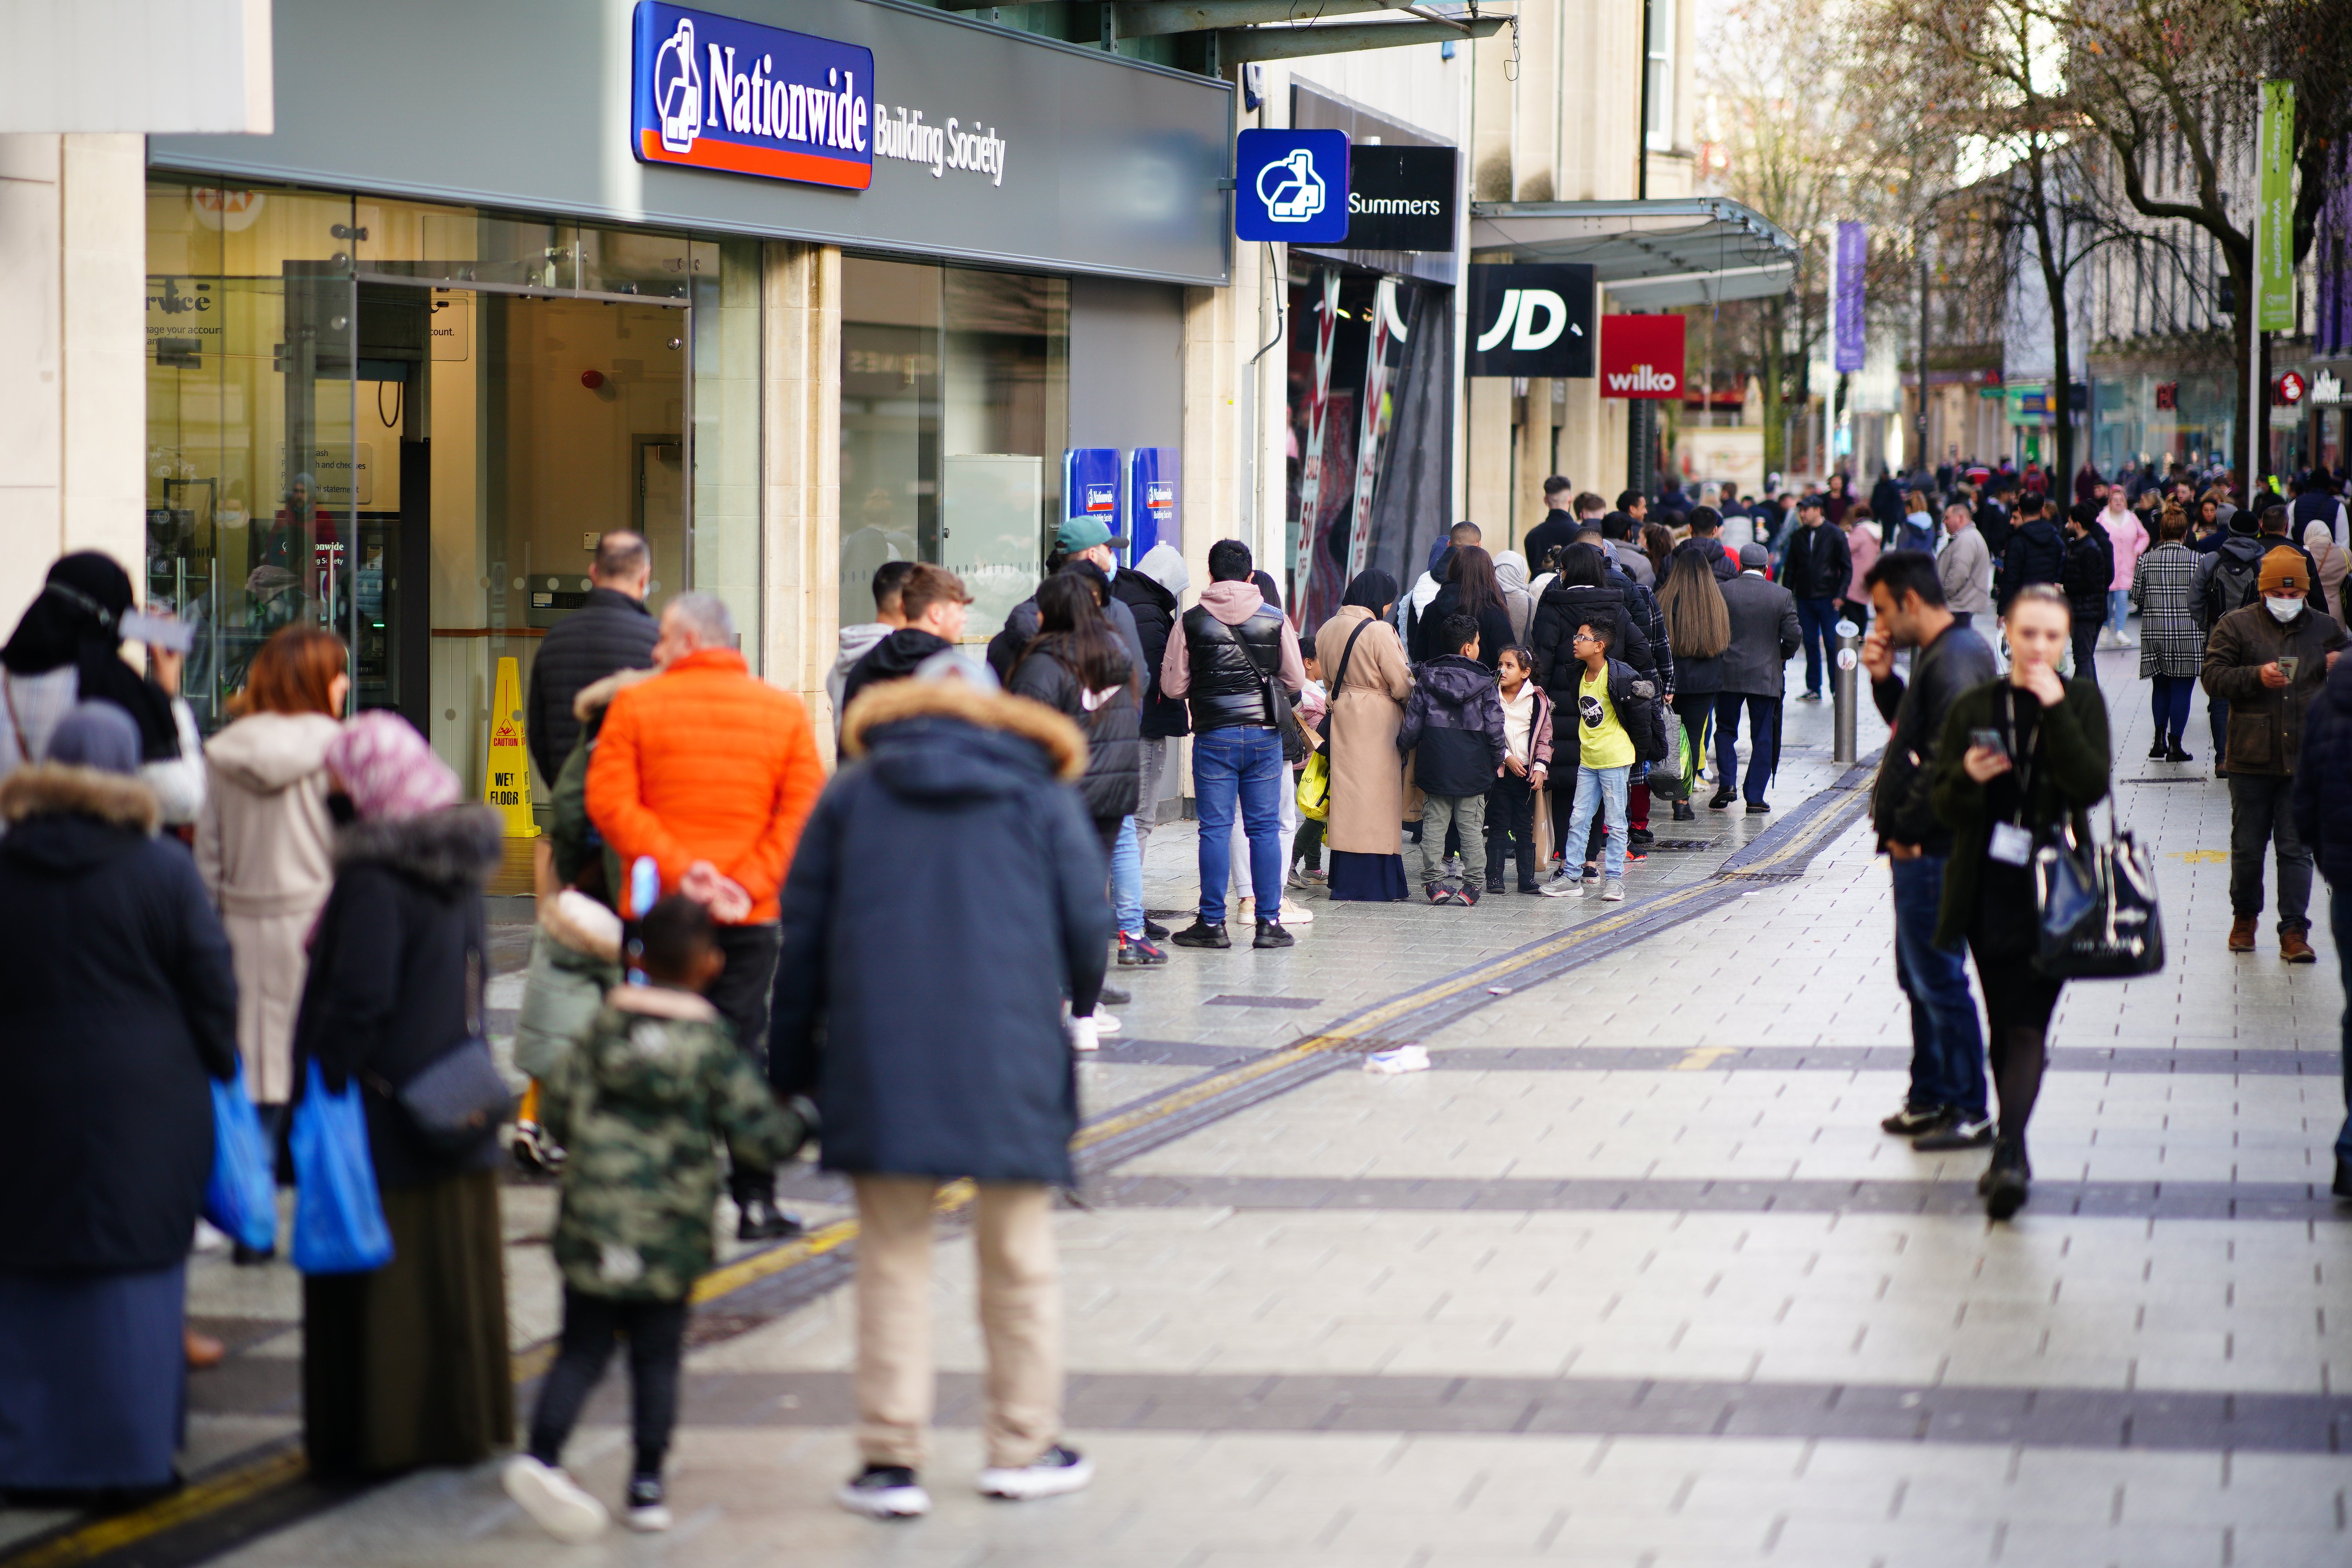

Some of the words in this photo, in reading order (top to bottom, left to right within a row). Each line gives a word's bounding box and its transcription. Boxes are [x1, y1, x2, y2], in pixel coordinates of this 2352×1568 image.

[707, 44, 867, 152] Nationwide
[875, 104, 943, 178] Building
[947, 117, 1005, 187] Society
[1348, 192, 1440, 215] Summers
[2273, 197, 2282, 279] Welcome
[1477, 289, 1567, 351] JD
[167, 327, 186, 335] your
[1608, 364, 1676, 391] wilko
[323, 485, 359, 493] statemet
[1154, 488, 1172, 501] Nationwide
[1093, 490, 1113, 503] Nationwide
[1104, 514, 1112, 523] Society
[1154, 511, 1164, 520] Building
[1164, 511, 1172, 521] Society
[1299, 501, 1313, 550] 50
[1298, 557, 1307, 578] OFF
[493, 738, 518, 746] CAUTION
[495, 773, 515, 786] WET
[490, 791, 518, 805] FLOOR
